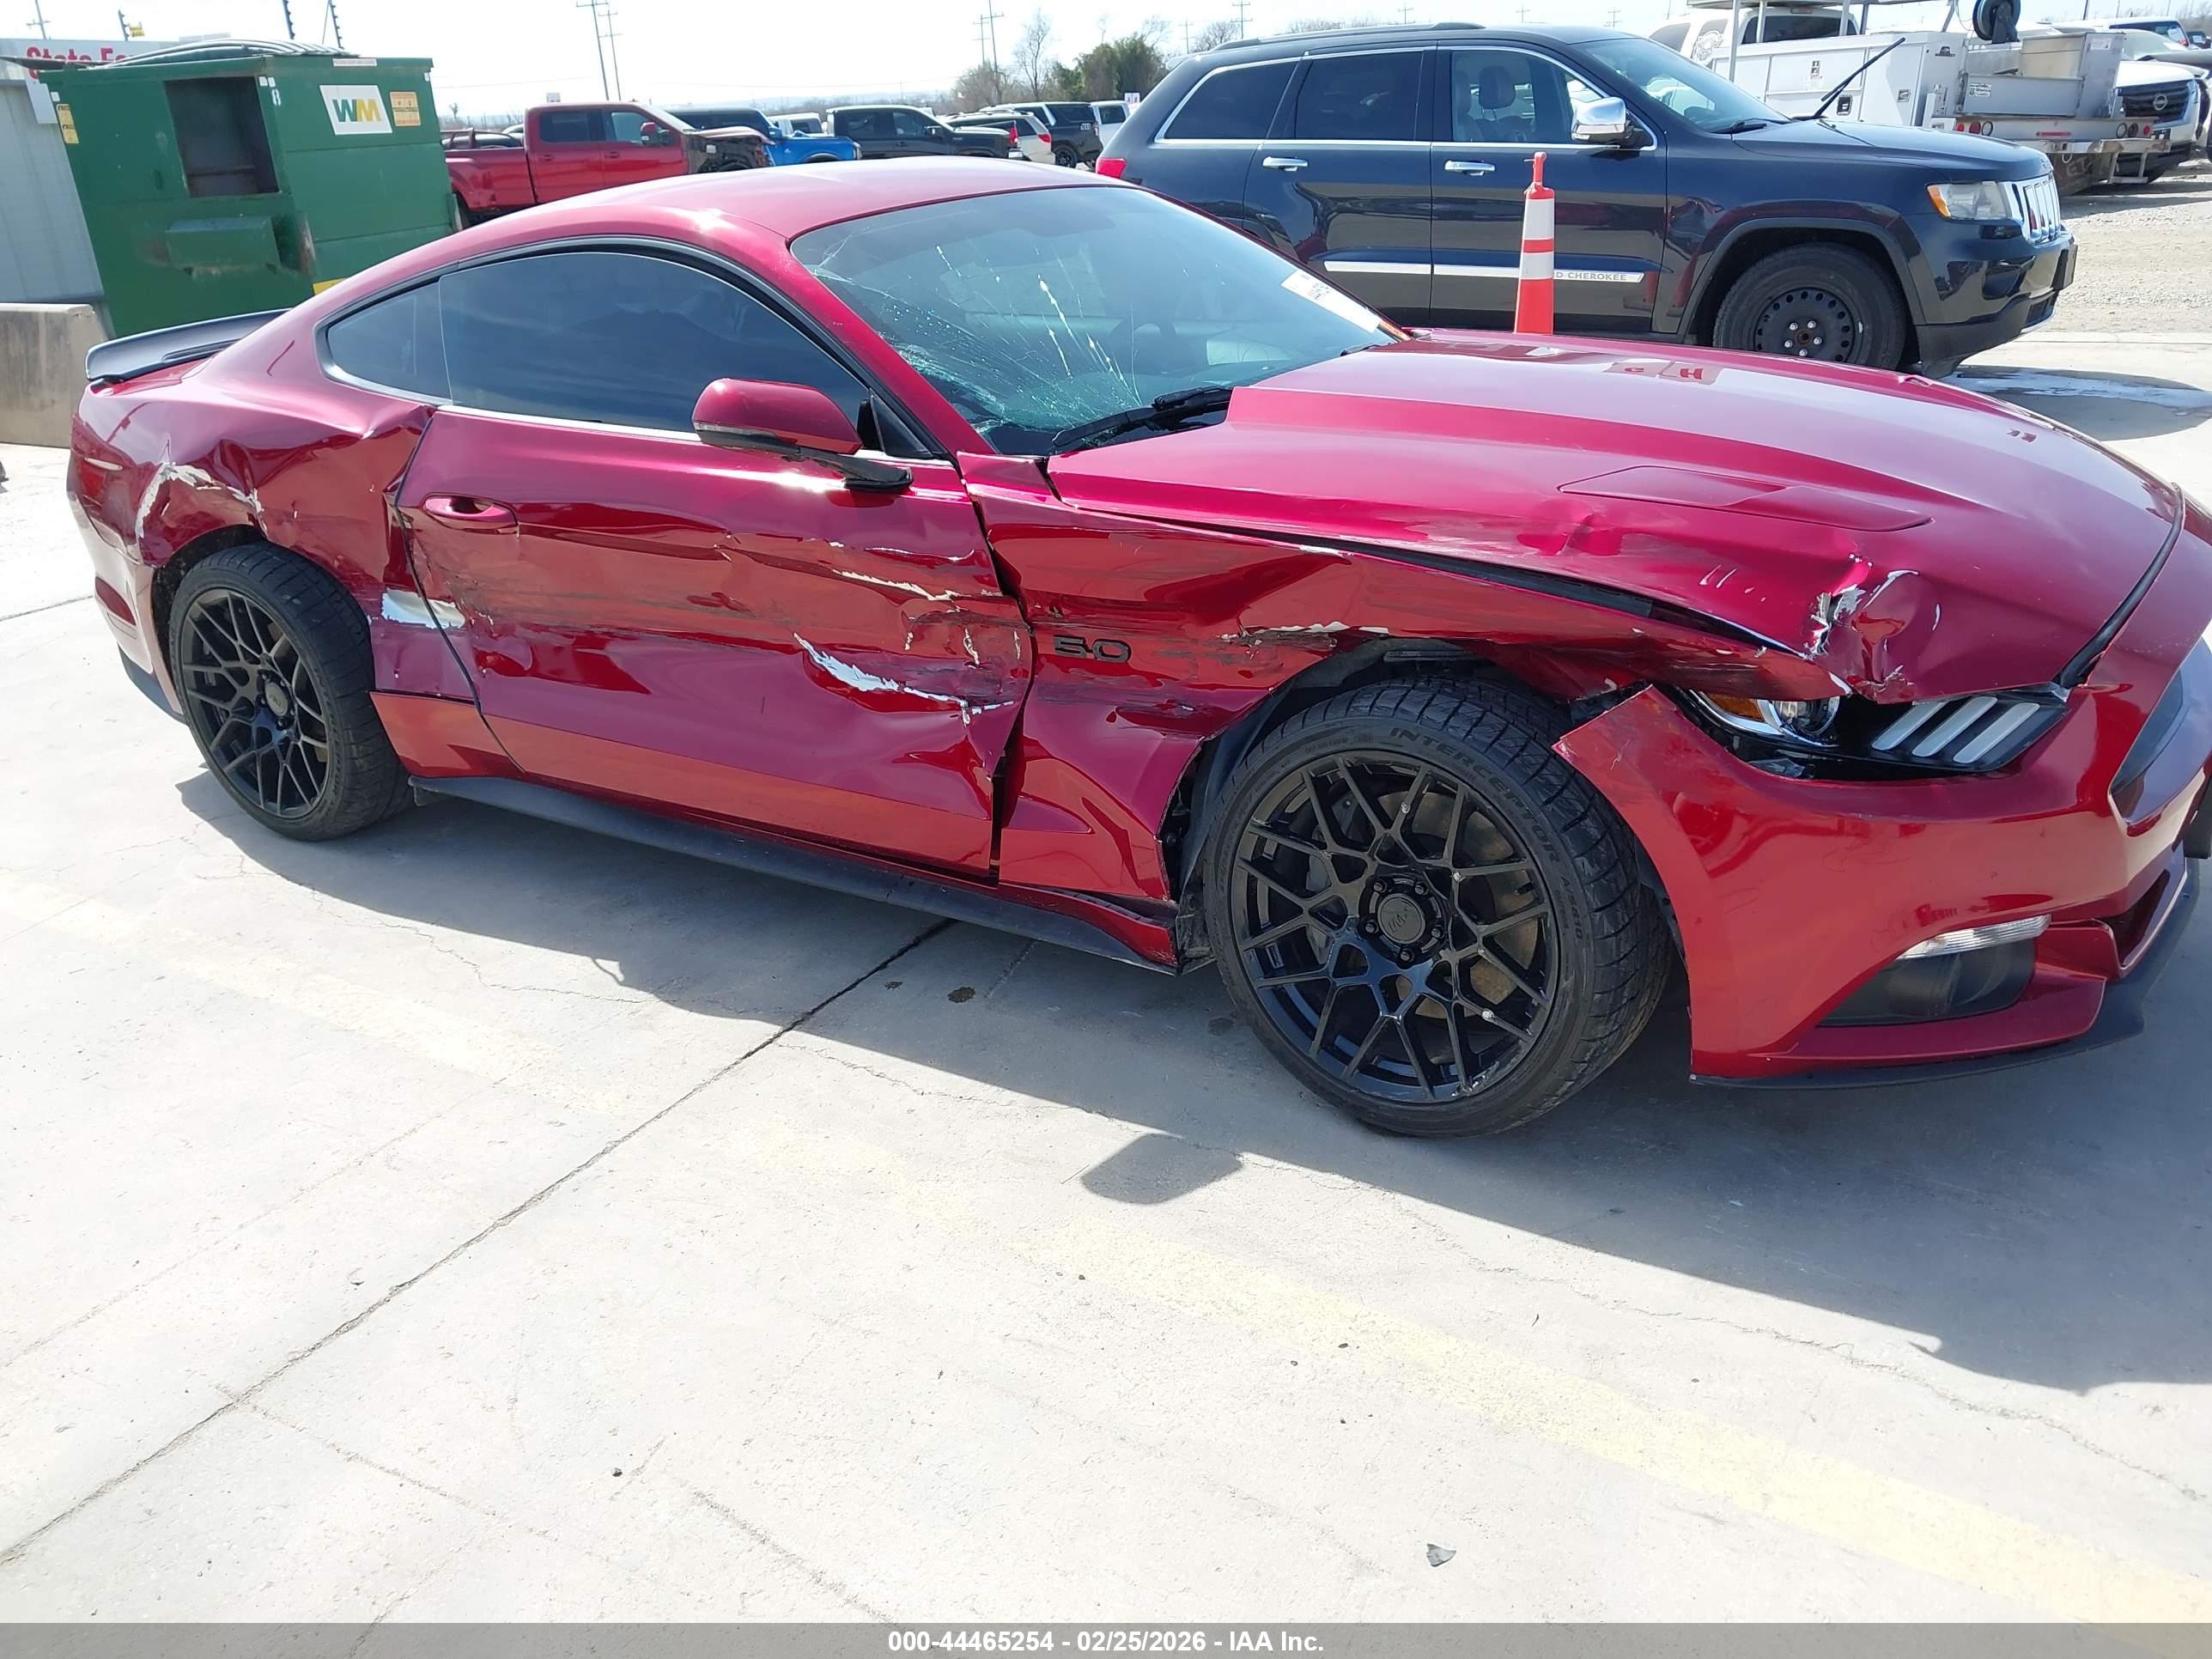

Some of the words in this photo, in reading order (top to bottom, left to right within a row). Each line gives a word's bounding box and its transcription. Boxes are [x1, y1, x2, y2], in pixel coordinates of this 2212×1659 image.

[331, 99, 381, 122] WM
[1567, 271, 1627, 282] CHEROKEE
[1389, 727, 1561, 863] INTERCEPTOR
